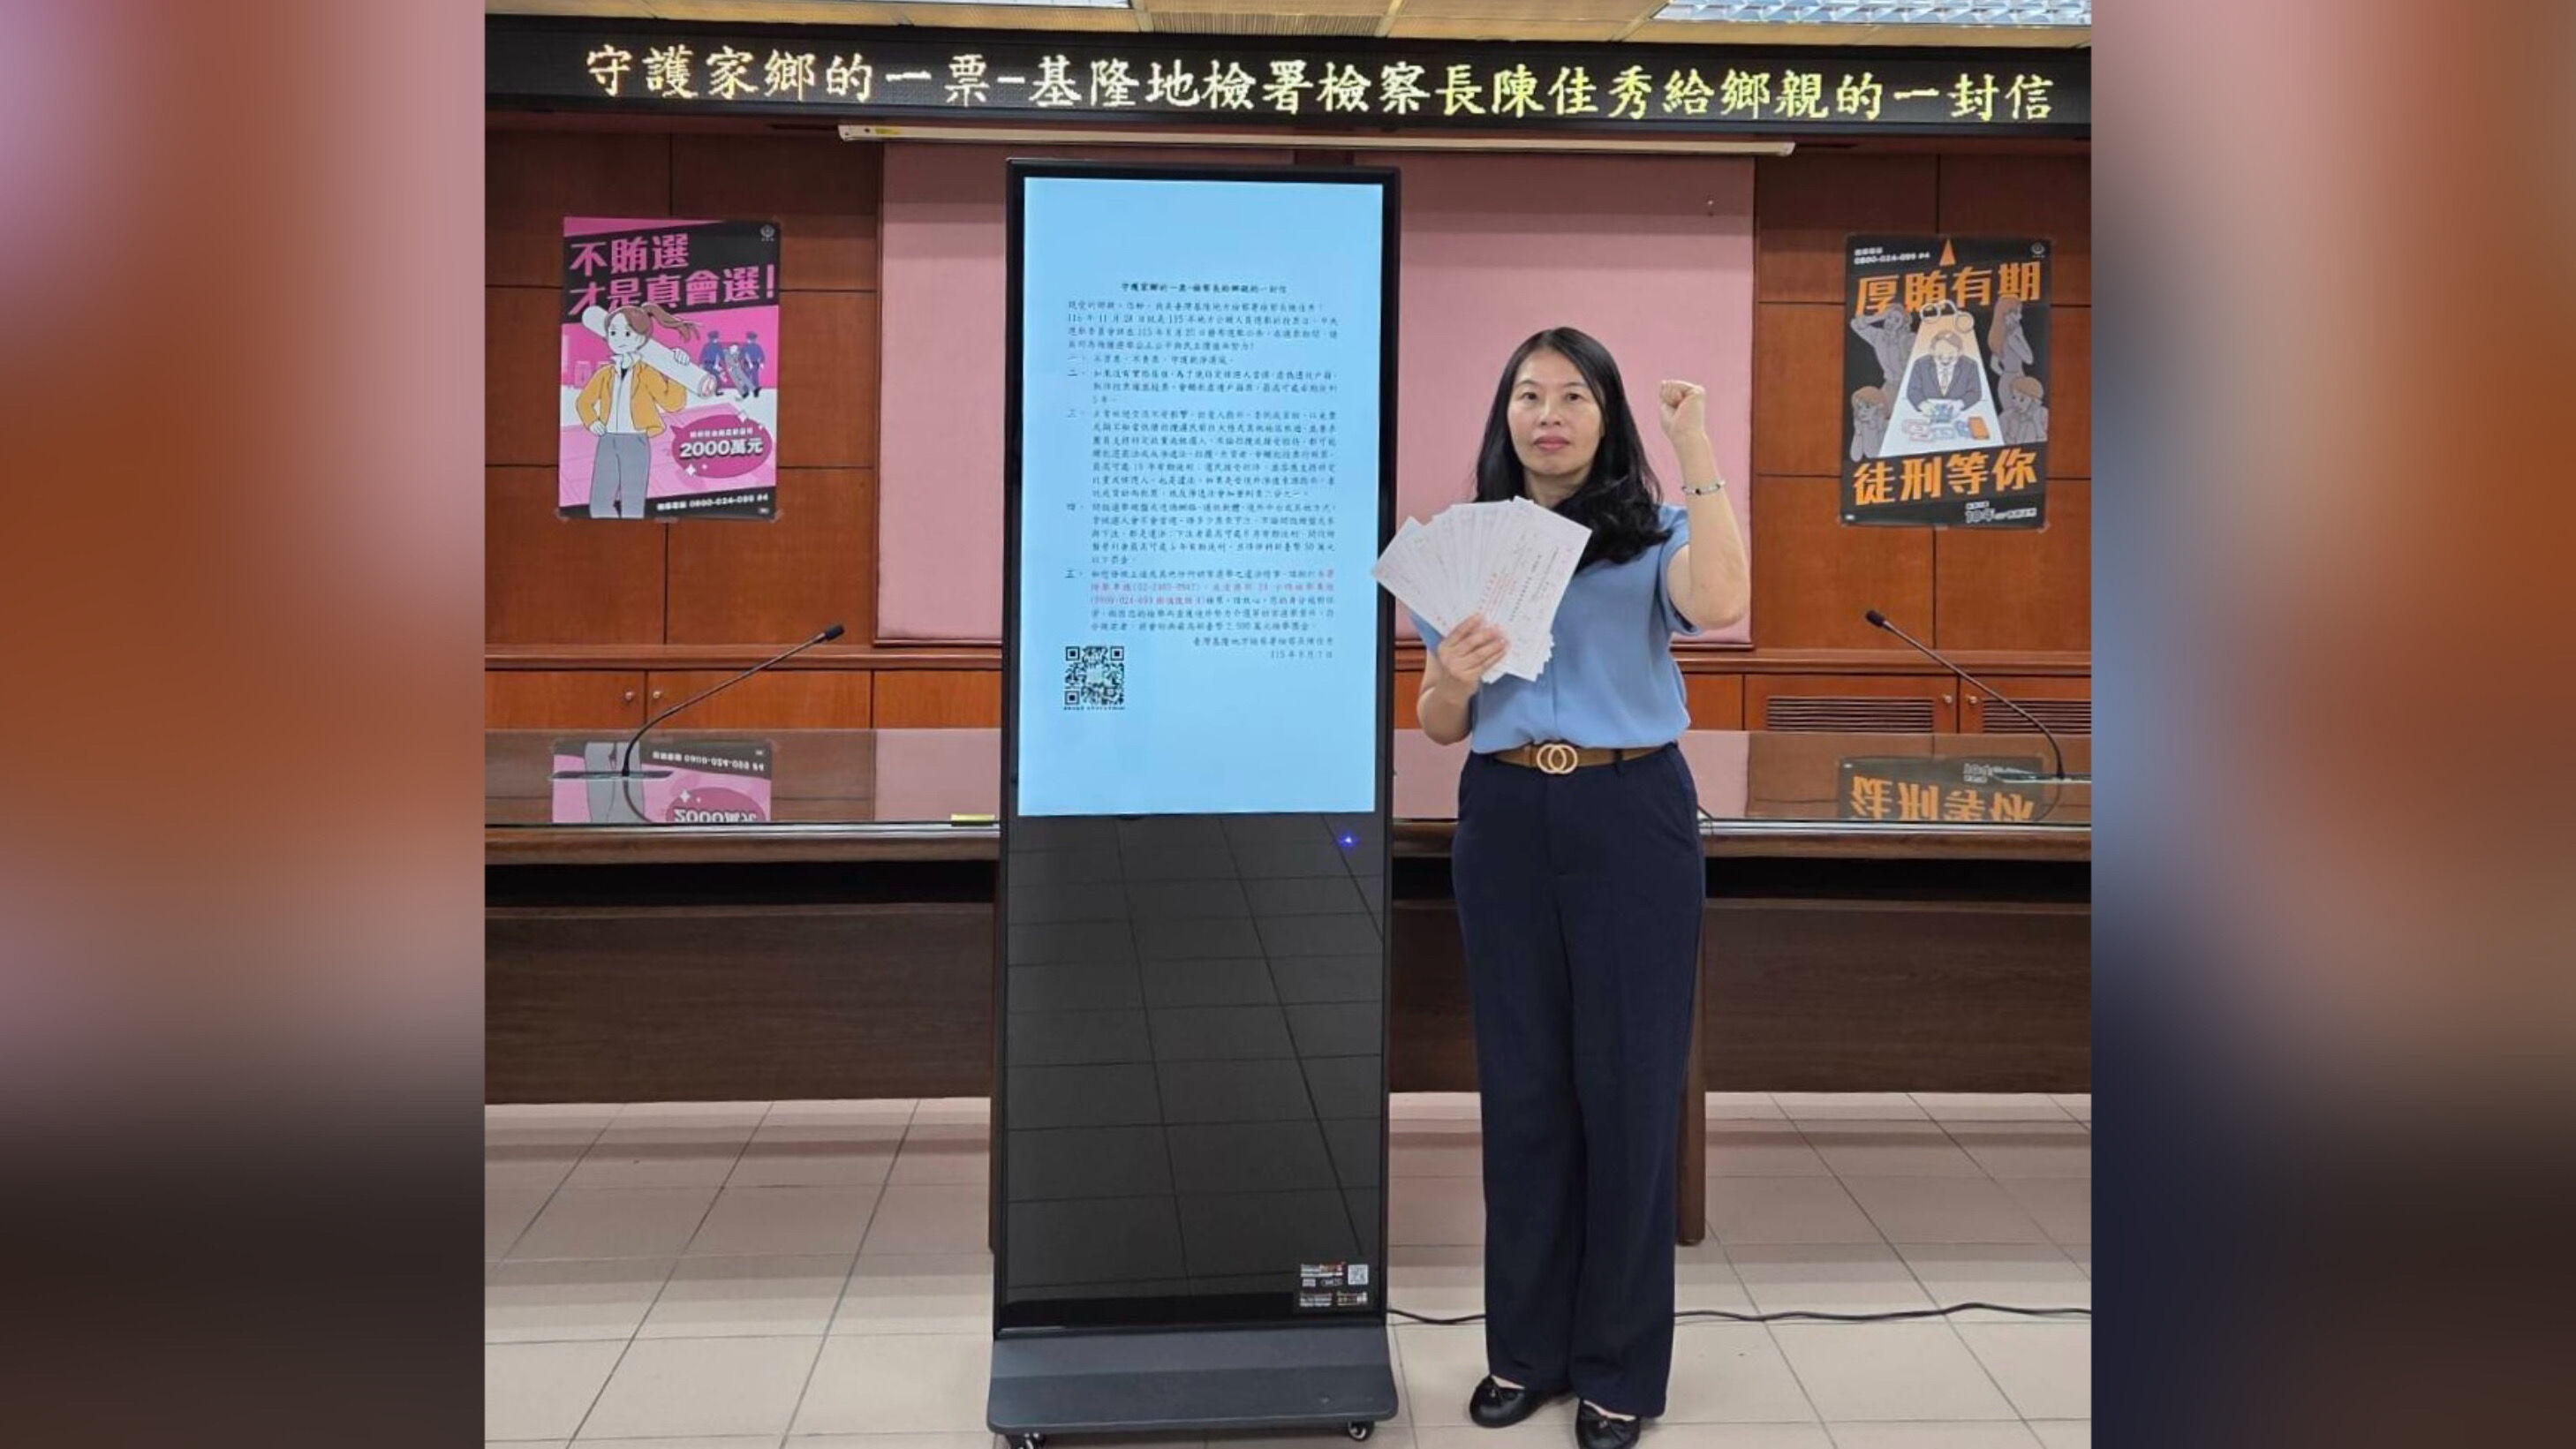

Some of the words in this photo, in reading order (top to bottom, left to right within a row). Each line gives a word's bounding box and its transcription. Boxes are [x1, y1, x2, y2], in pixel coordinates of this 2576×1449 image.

[569, 232, 690, 277] 不賄選
[1855, 260, 2041, 316] 厚賄有期
[679, 437, 763, 458] 2000萬元
[1853, 446, 2037, 507] 徒刑等你
